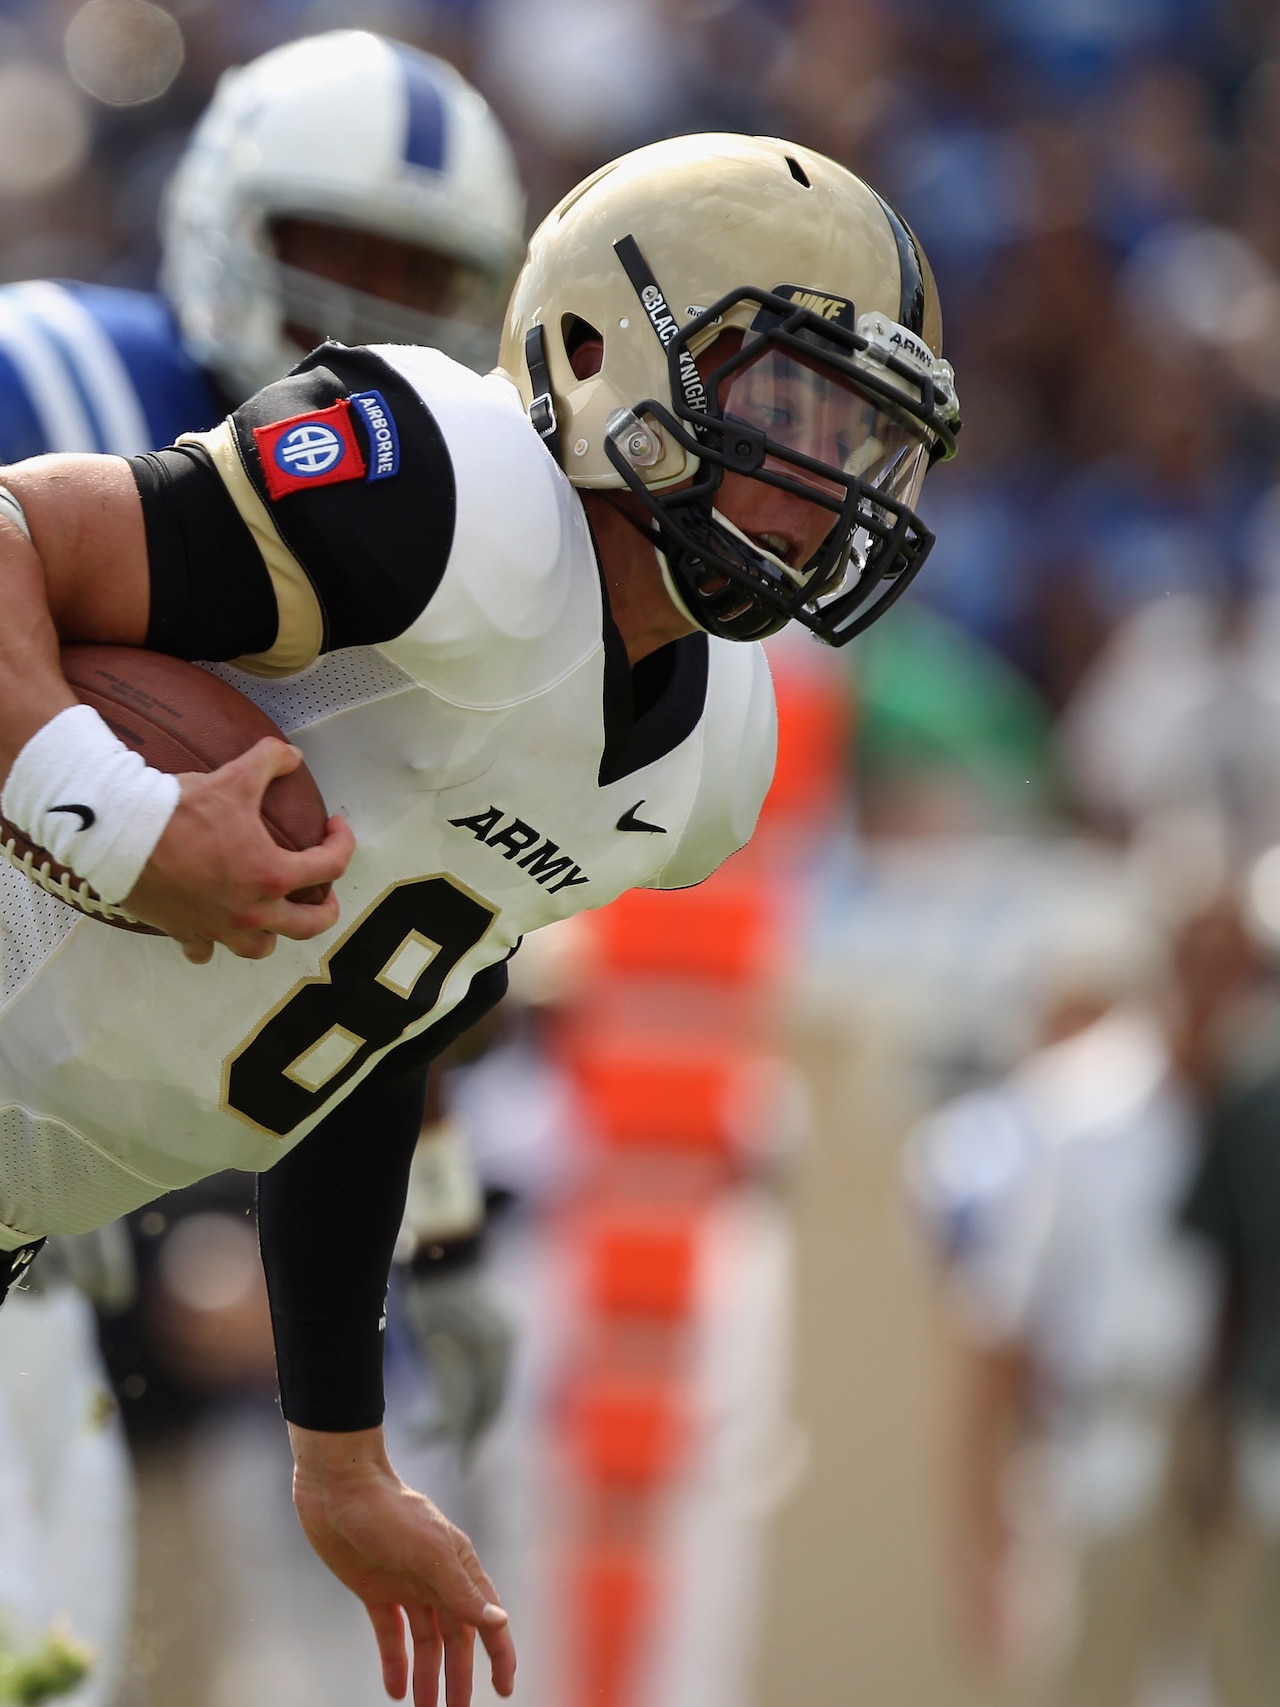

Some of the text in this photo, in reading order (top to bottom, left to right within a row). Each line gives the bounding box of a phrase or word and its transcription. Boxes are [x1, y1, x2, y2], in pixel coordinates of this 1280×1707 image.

[644, 293, 680, 346] BLAC
[889, 331, 933, 368] ARMY
[359, 397, 394, 475] AIRBORNE
[446, 805, 591, 895] ARMY
[220, 871, 503, 1142] 8
